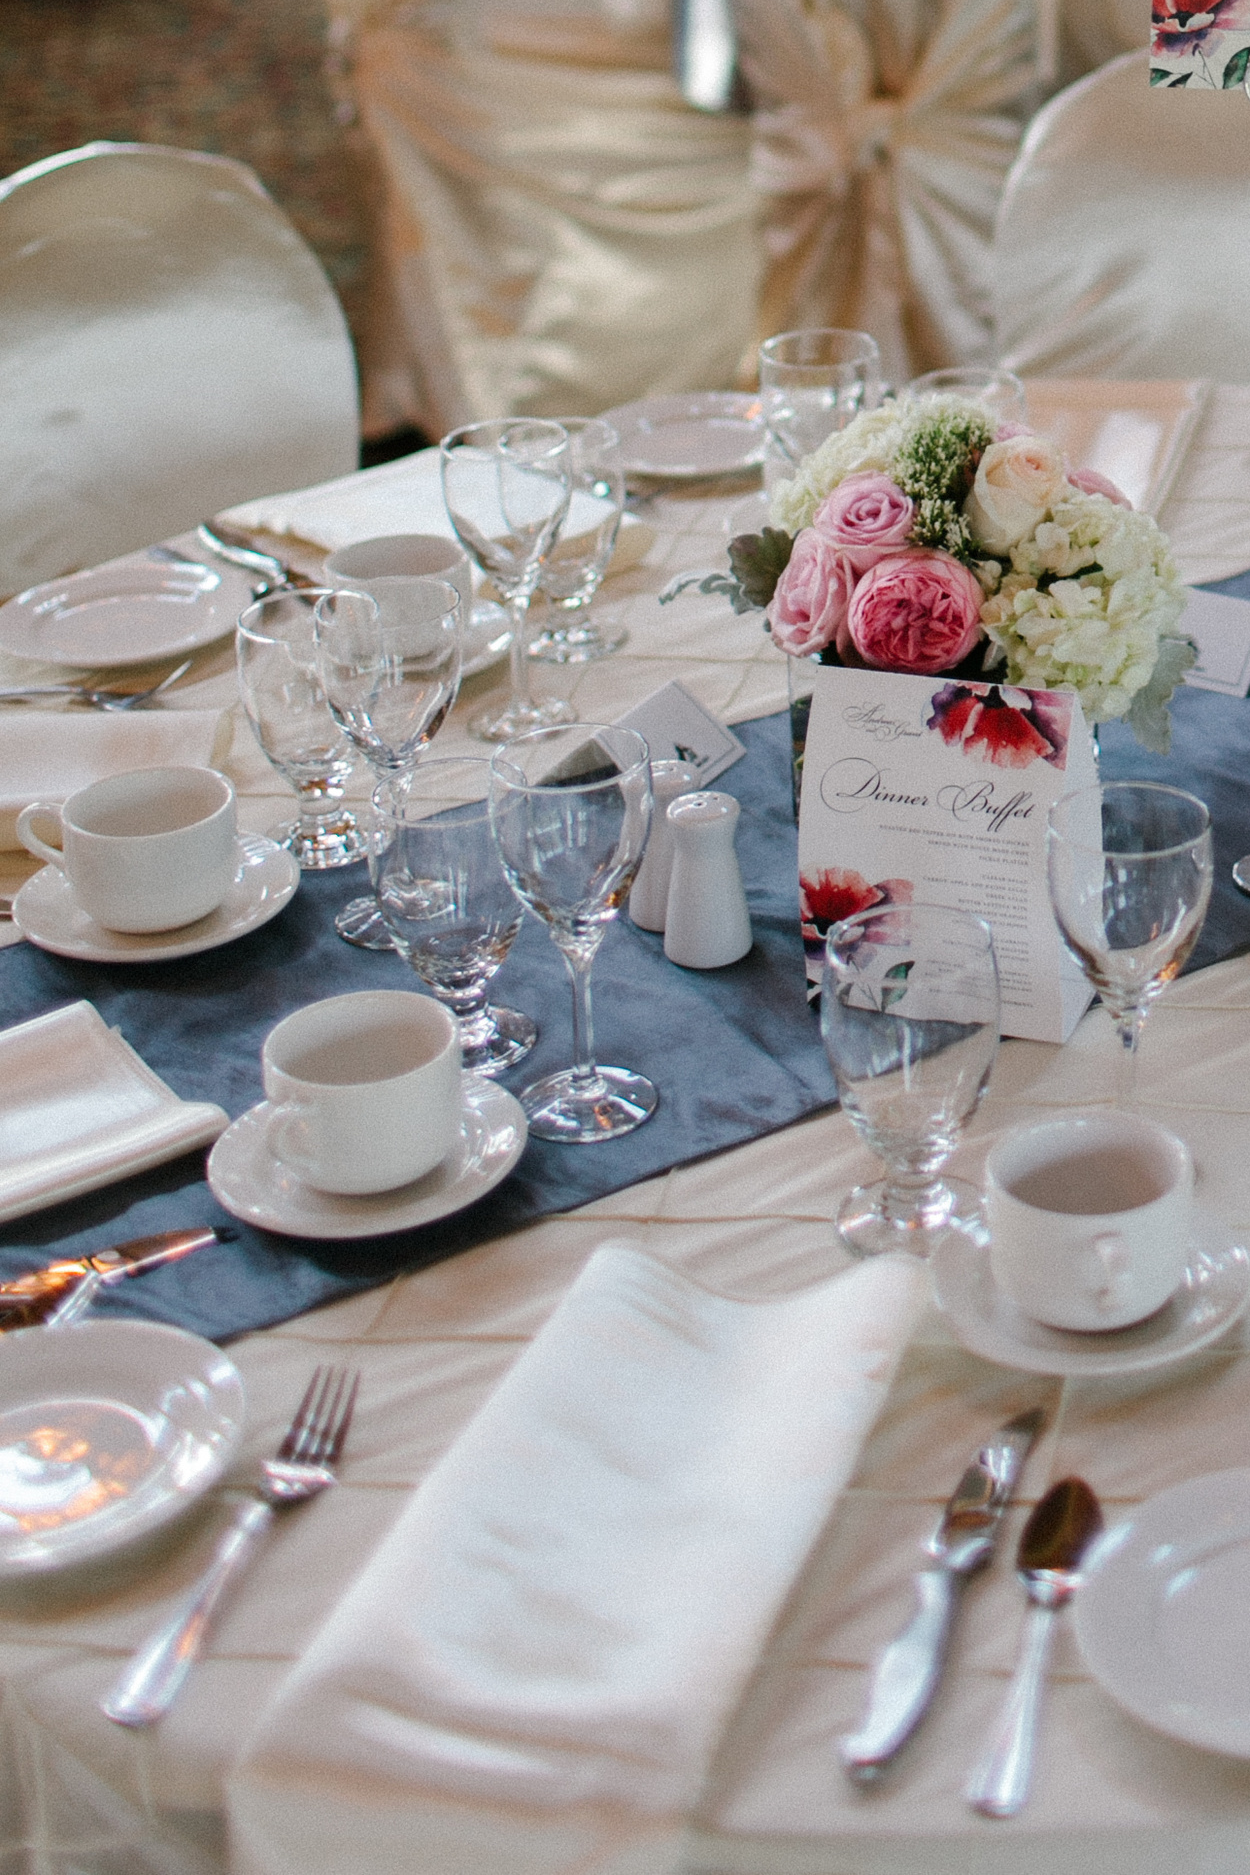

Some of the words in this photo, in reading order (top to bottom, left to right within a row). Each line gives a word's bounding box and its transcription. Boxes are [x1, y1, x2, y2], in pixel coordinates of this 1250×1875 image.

[842, 702, 895, 729] Andrea
[819, 756, 930, 814] Dinner
[936, 779, 1036, 833] Buffet
